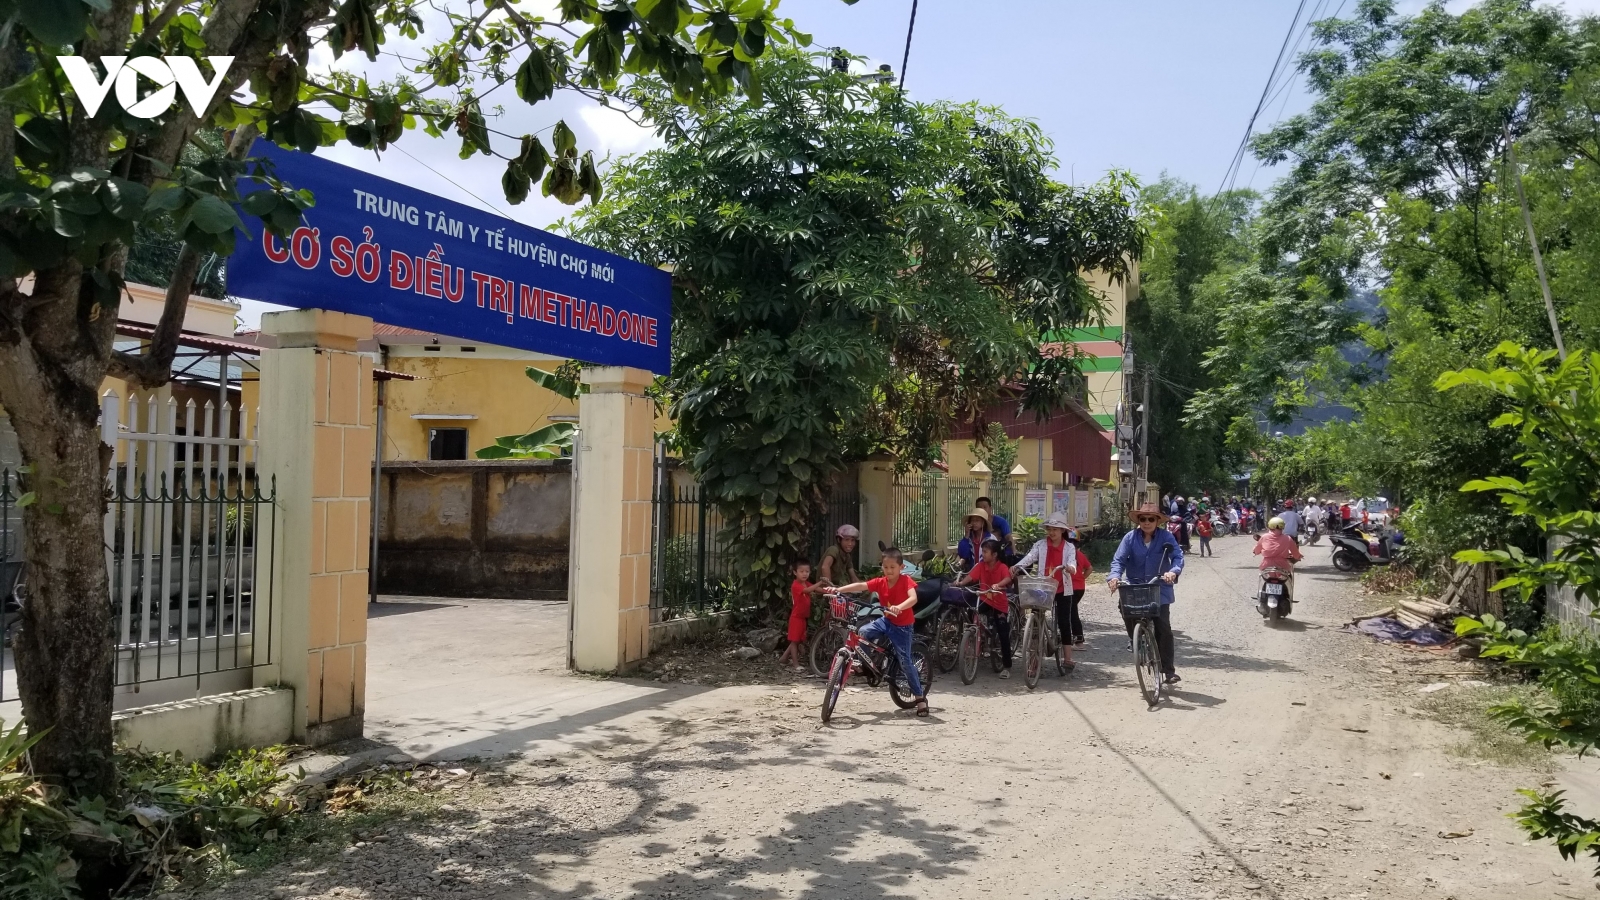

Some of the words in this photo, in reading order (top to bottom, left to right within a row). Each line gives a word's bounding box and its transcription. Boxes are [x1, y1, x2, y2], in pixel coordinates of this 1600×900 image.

[262, 226, 321, 270] CƠ
[329, 225, 381, 284] SỞ
[388, 242, 465, 303] ĐIỀU
[471, 270, 515, 325] TRỊ
[519, 283, 658, 348] METHADONE
[353, 188, 419, 226] TRUNG
[424, 210, 463, 239] TÂM
[468, 224, 480, 243] Y
[484, 227, 506, 251] TẾ
[507, 236, 557, 268] HUYỆN
[560, 253, 588, 279] CHỢ
[591, 262, 615, 284] MỚI
